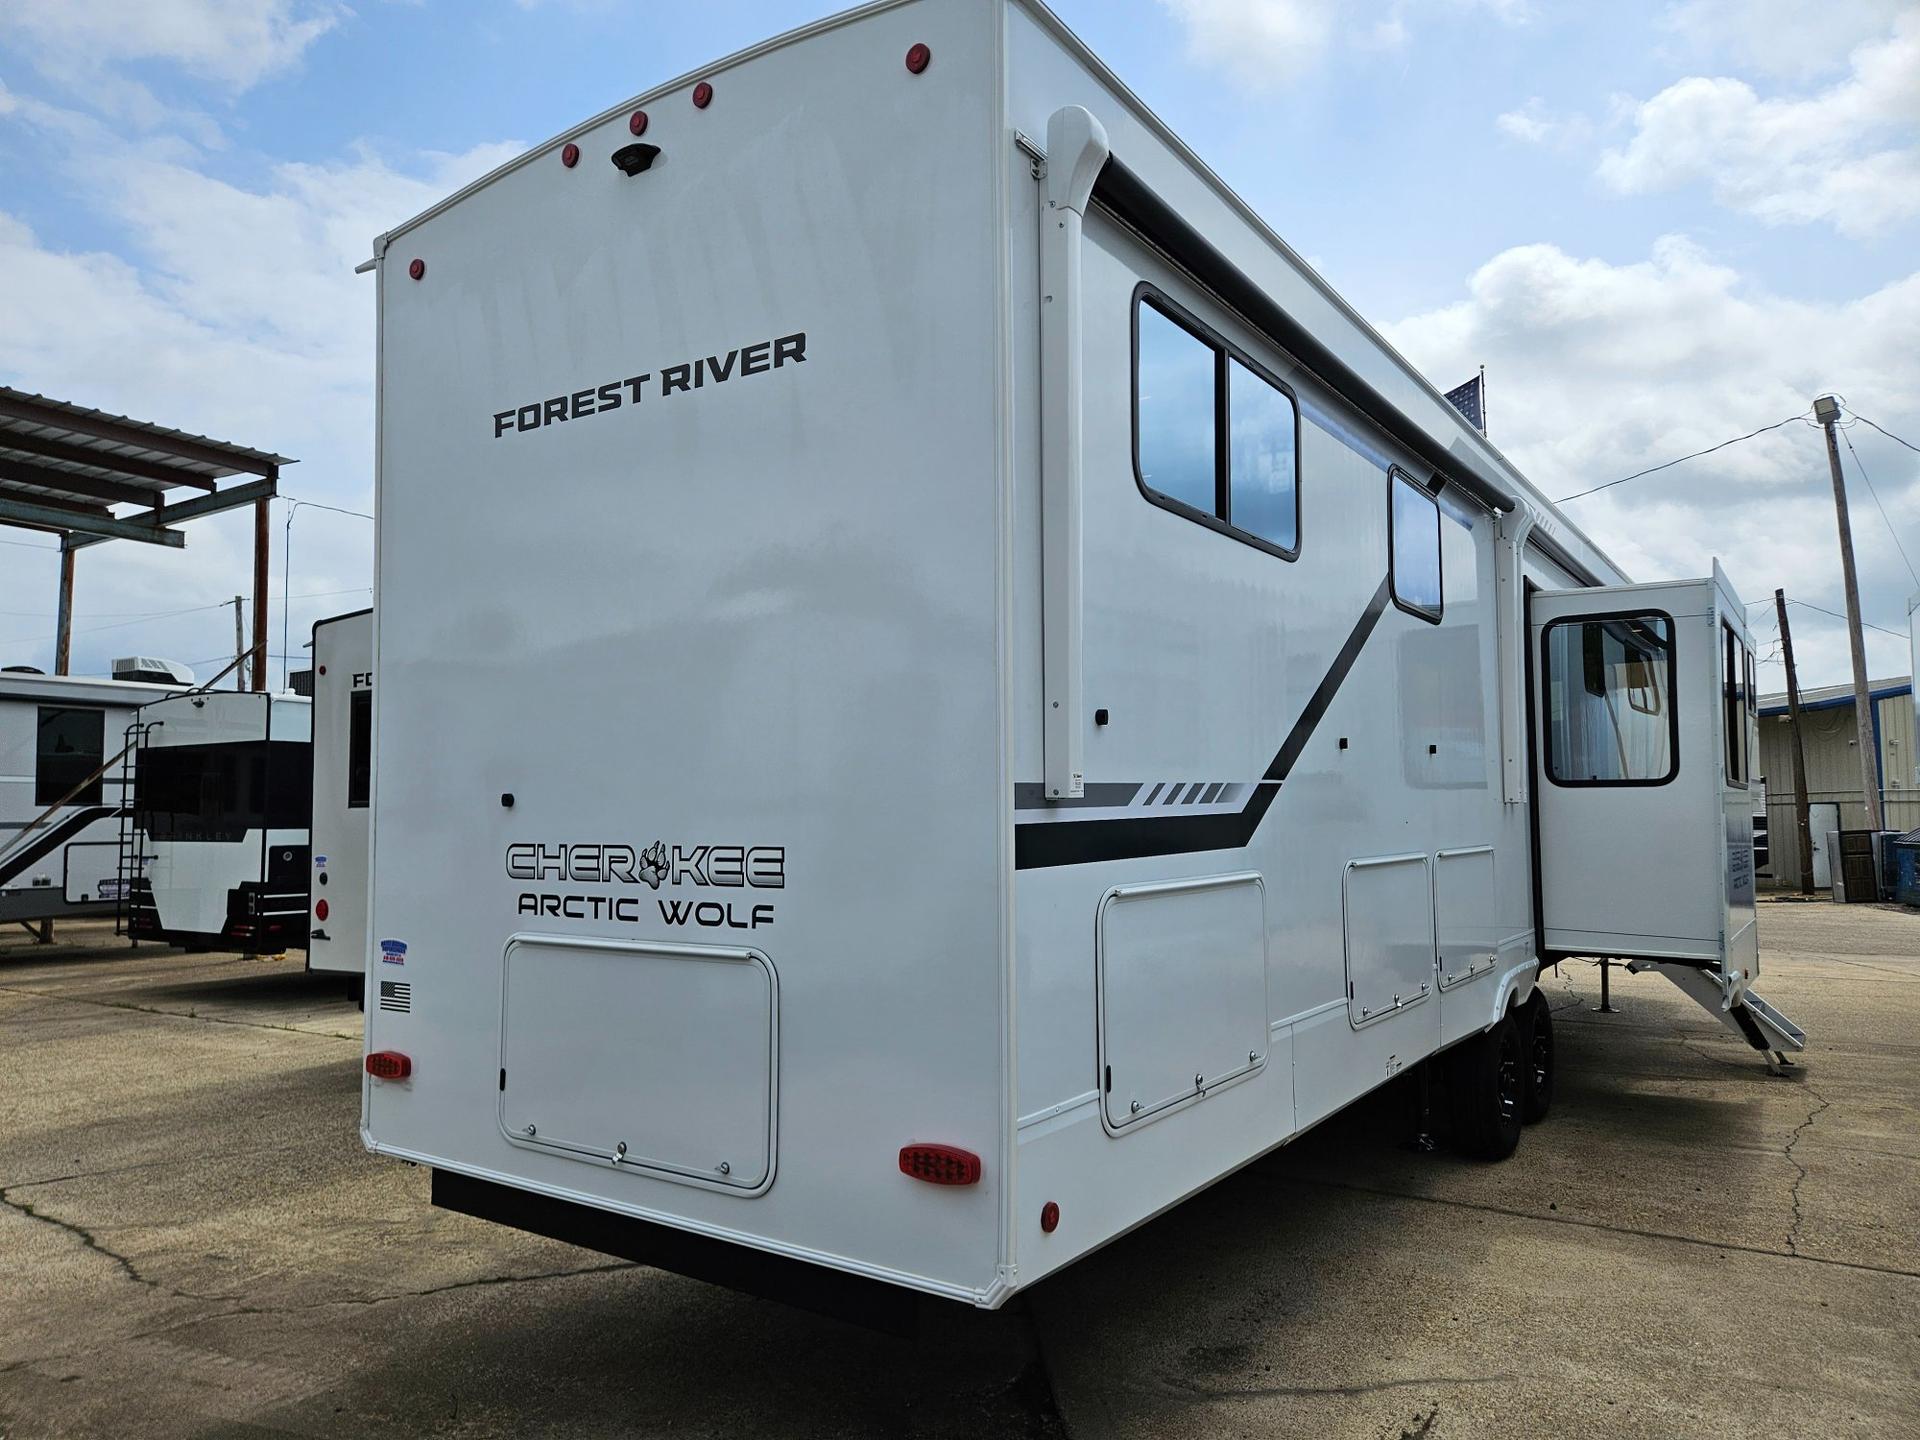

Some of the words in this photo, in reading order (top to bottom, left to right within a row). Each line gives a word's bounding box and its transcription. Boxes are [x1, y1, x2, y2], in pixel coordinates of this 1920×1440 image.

[492, 373, 651, 439] FOREST
[660, 332, 807, 396] RIVER
[505, 841, 785, 890] CHEROKEE
[518, 893, 639, 922] ARCTIC
[657, 900, 774, 929] WOLF
